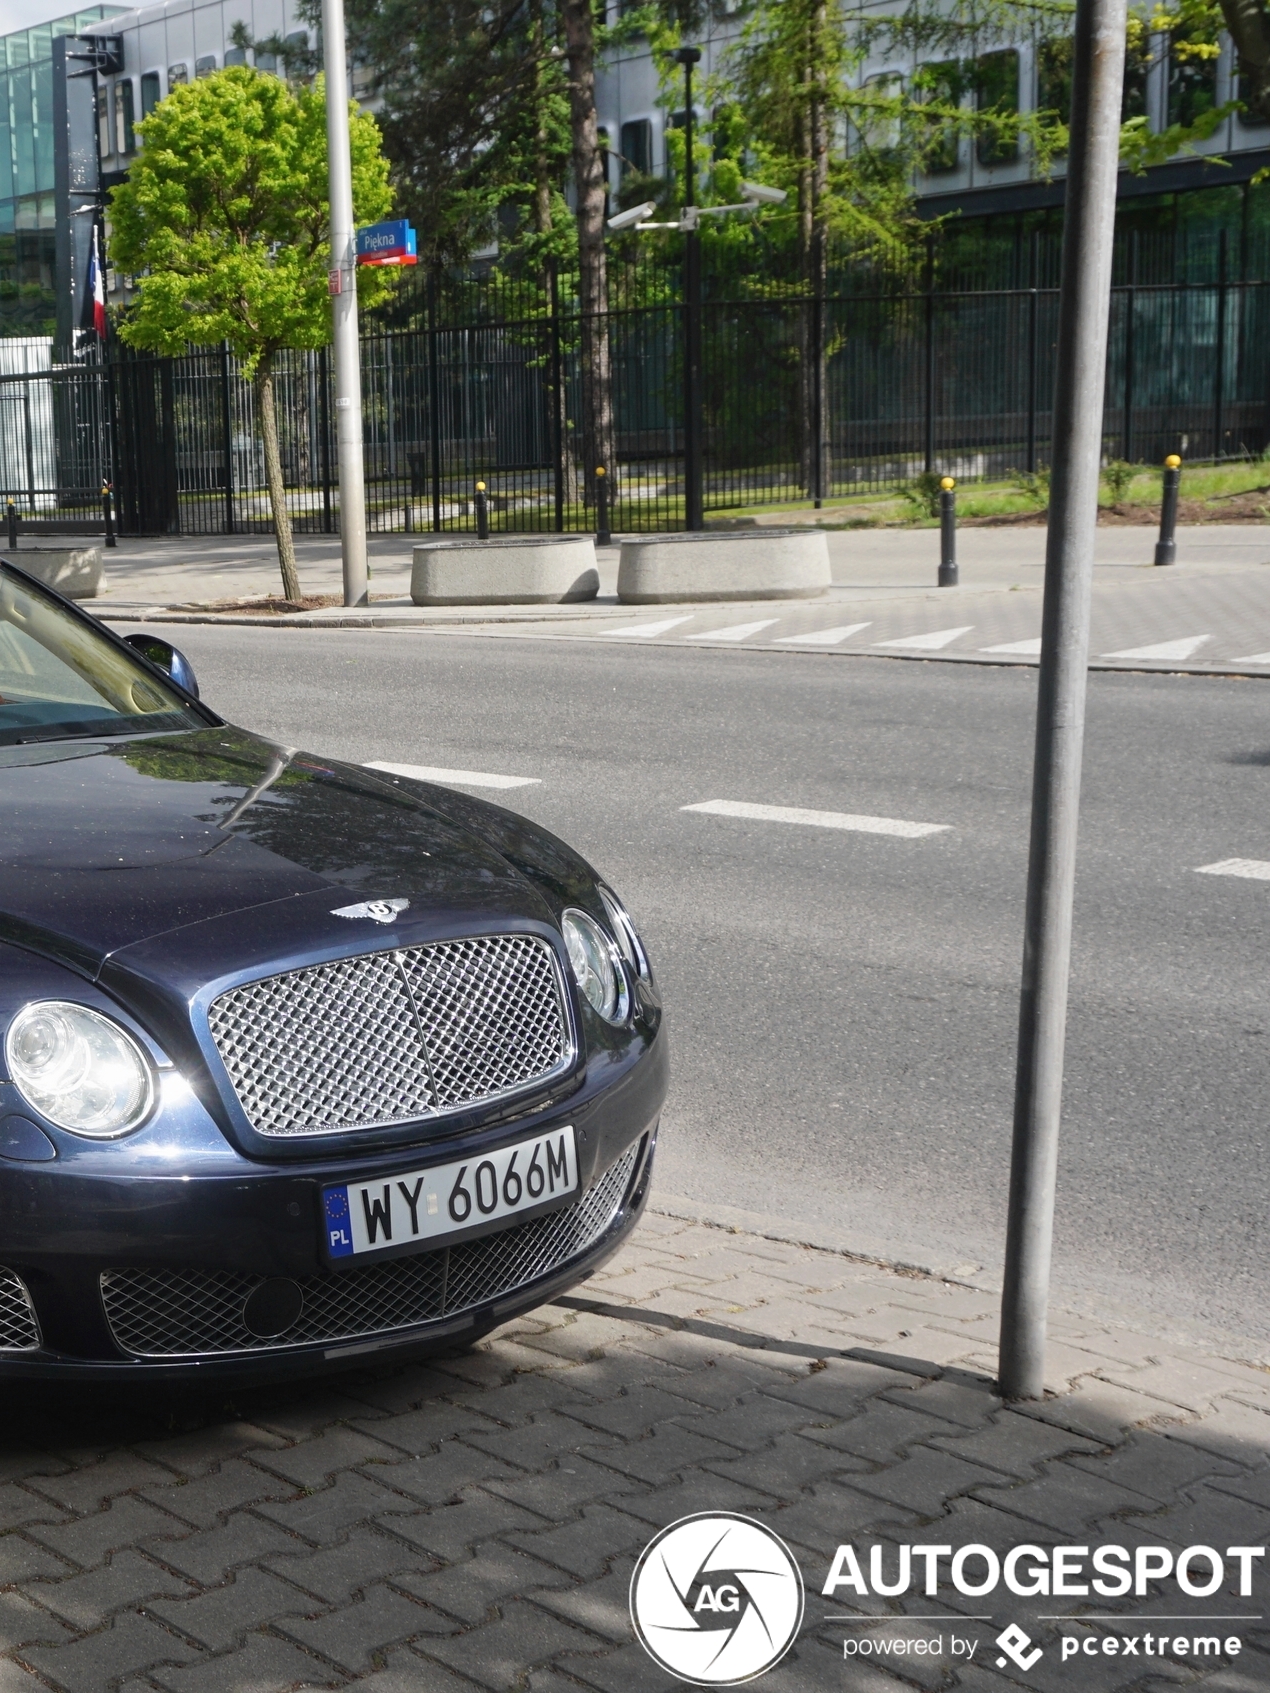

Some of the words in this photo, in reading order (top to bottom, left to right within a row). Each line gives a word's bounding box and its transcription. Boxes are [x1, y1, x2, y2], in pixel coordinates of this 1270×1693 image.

[364, 233, 395, 251] Piękna
[361, 1176, 425, 1244] WY
[449, 1134, 569, 1222] 6066M
[330, 1230, 349, 1246] PL
